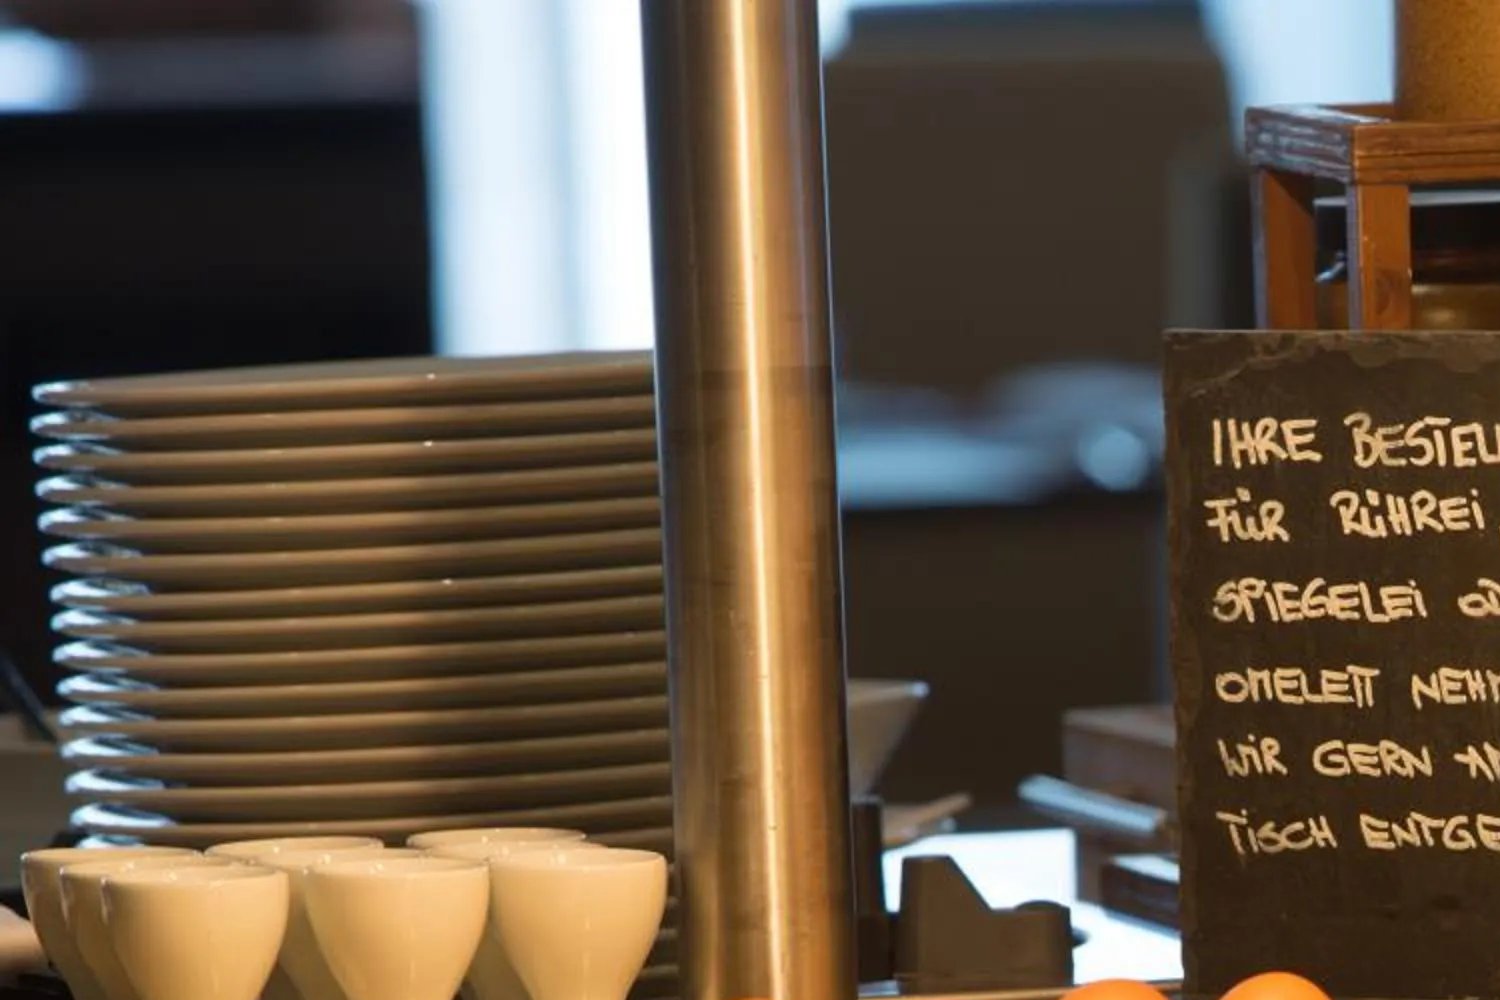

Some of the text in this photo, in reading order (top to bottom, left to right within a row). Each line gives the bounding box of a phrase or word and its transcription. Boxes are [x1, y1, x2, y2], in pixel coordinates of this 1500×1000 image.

[1213, 416, 1323, 470] IHRE
[1216, 664, 1381, 709] OMELETT
[1312, 739, 1433, 779] GERN
